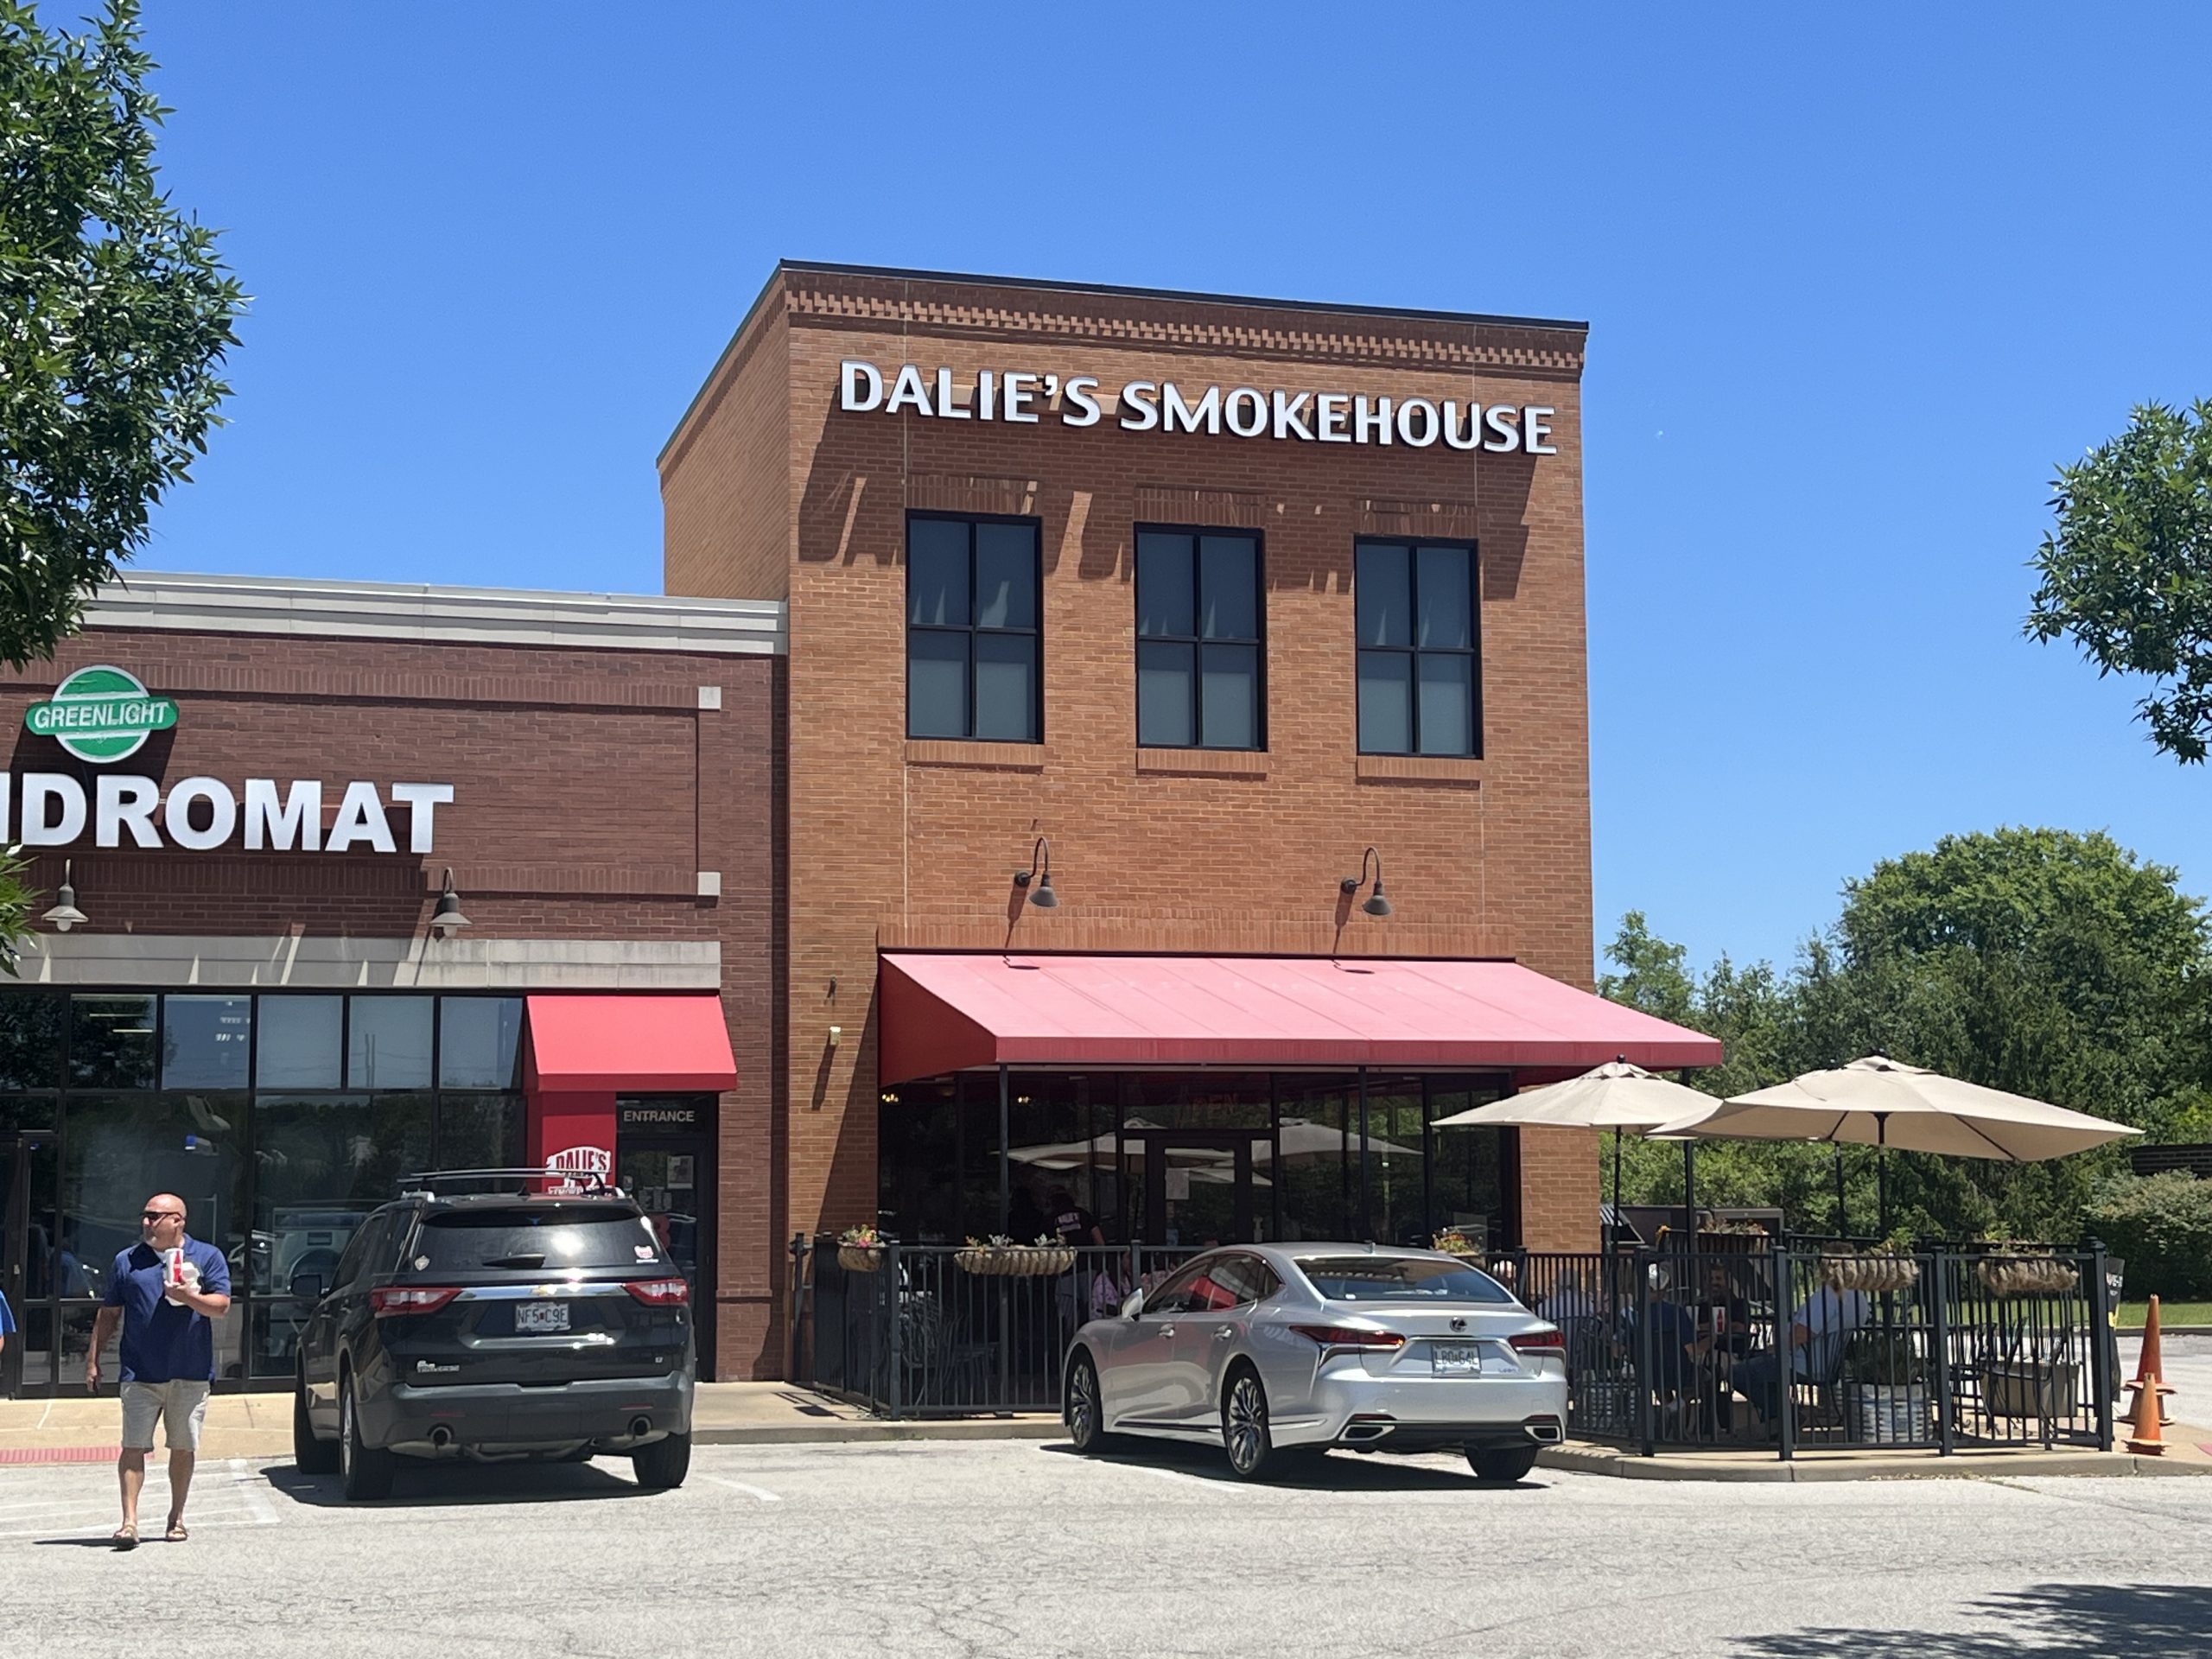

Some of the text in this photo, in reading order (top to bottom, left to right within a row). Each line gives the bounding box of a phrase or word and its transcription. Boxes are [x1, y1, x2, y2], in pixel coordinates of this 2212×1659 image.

[840, 359, 1557, 455] DALIE'S SMOKEHOUSE
[34, 701, 170, 729] GREENLIGHT
[623, 1109, 695, 1122] ENTRANCE
